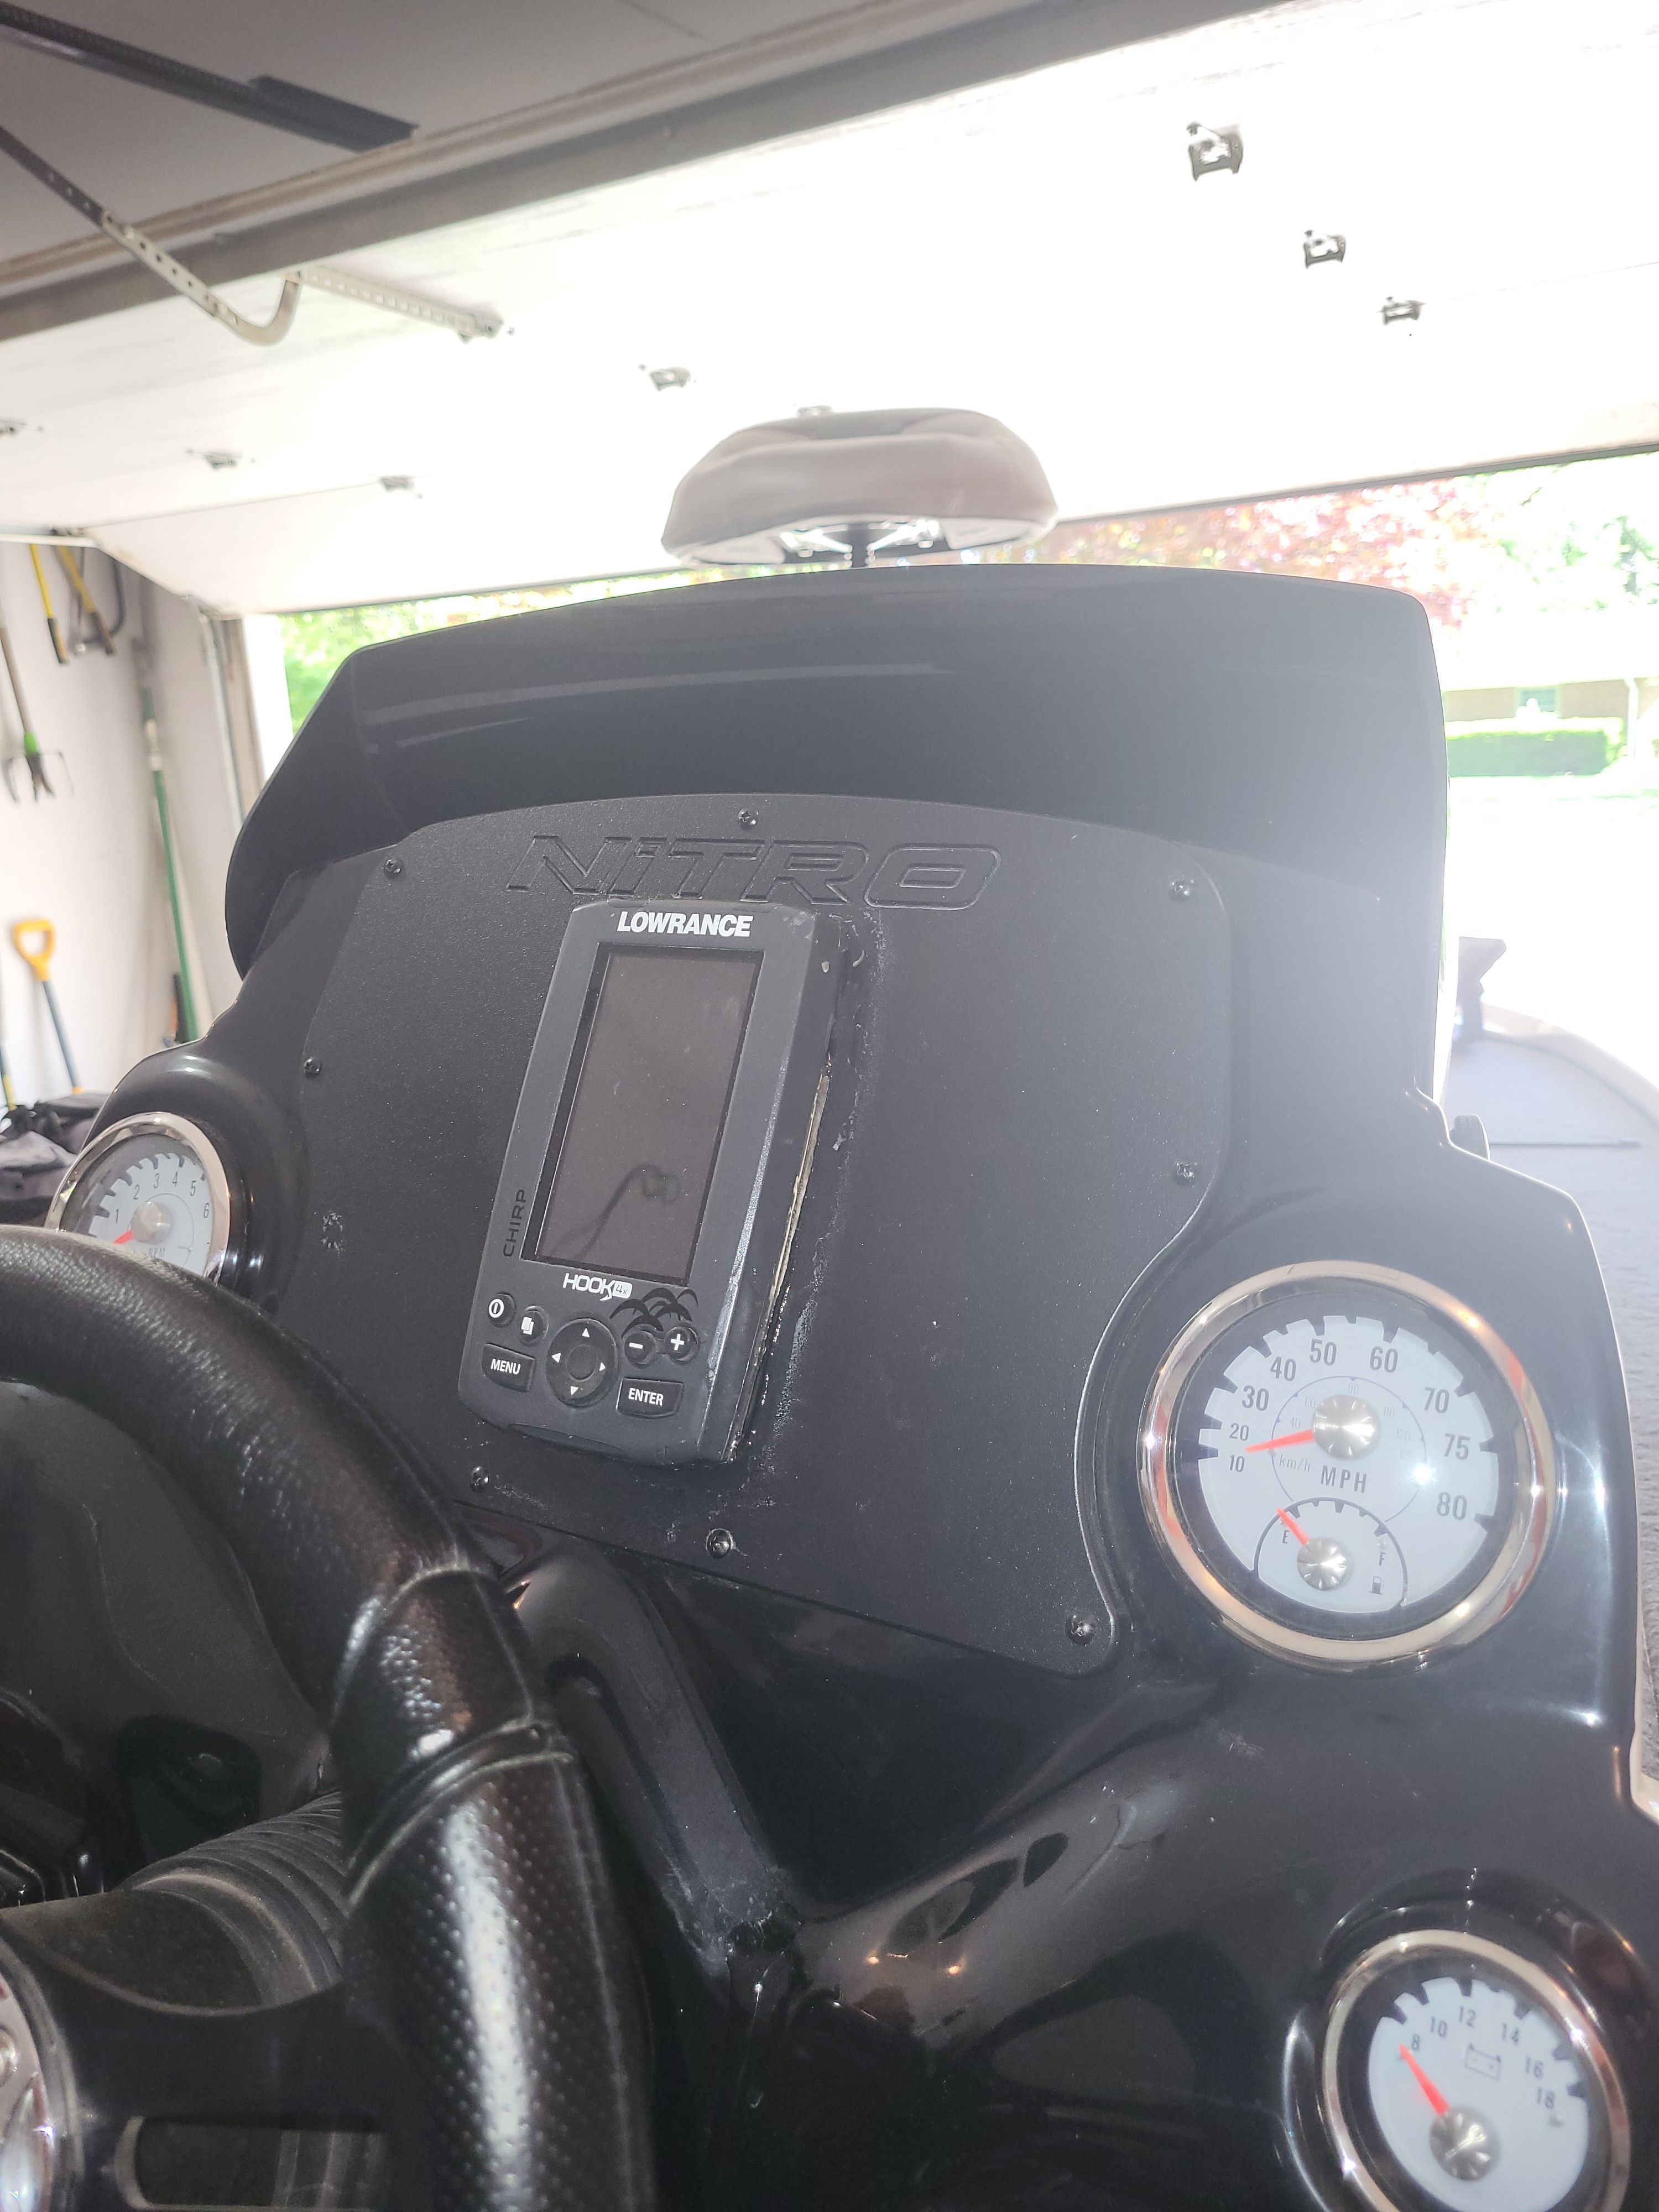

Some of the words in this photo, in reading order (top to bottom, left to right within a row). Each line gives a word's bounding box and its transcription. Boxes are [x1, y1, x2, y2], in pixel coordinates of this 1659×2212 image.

[617, 911, 754, 937] LOWRANCE
[154, 1173, 160, 1189] 3
[173, 1171, 179, 1187] 4
[190, 1180, 197, 1196] 5
[133, 1184, 140, 1200] 2
[115, 1208, 119, 1224] 1
[204, 1203, 210, 1218] 6
[503, 1189, 526, 1258] CHIRP
[562, 1272, 615, 1301] HOOK
[1310, 1339, 1337, 1366] 50
[1370, 1347, 1399, 1373] 60
[491, 1358, 521, 1375] MENU
[1270, 1357, 1297, 1382] 40
[628, 1388, 664, 1406] ENTER
[1241, 1385, 1269, 1412] 30
[1348, 1384, 1359, 1394] 90
[1424, 1387, 1450, 1413] 70
[1229, 1423, 1249, 1441] 20
[1443, 1433, 1469, 1460] 75
[1229, 1455, 1245, 1473] 10
[1279, 1454, 1310, 1472] km/h
[1321, 1465, 1367, 1493] MPH
[1437, 1492, 1467, 1520] 80
[1282, 1530, 1290, 1544] E
[1378, 1551, 1386, 1566] F
[1431, 2016, 1447, 2037] 10
[1458, 2006, 1476, 2027] 12
[1411, 2034, 1420, 2050] 8
[1501, 2023, 1520, 2046] 14
[1525, 2056, 1543, 2079] 16
[1537, 2088, 1554, 2109] 18
